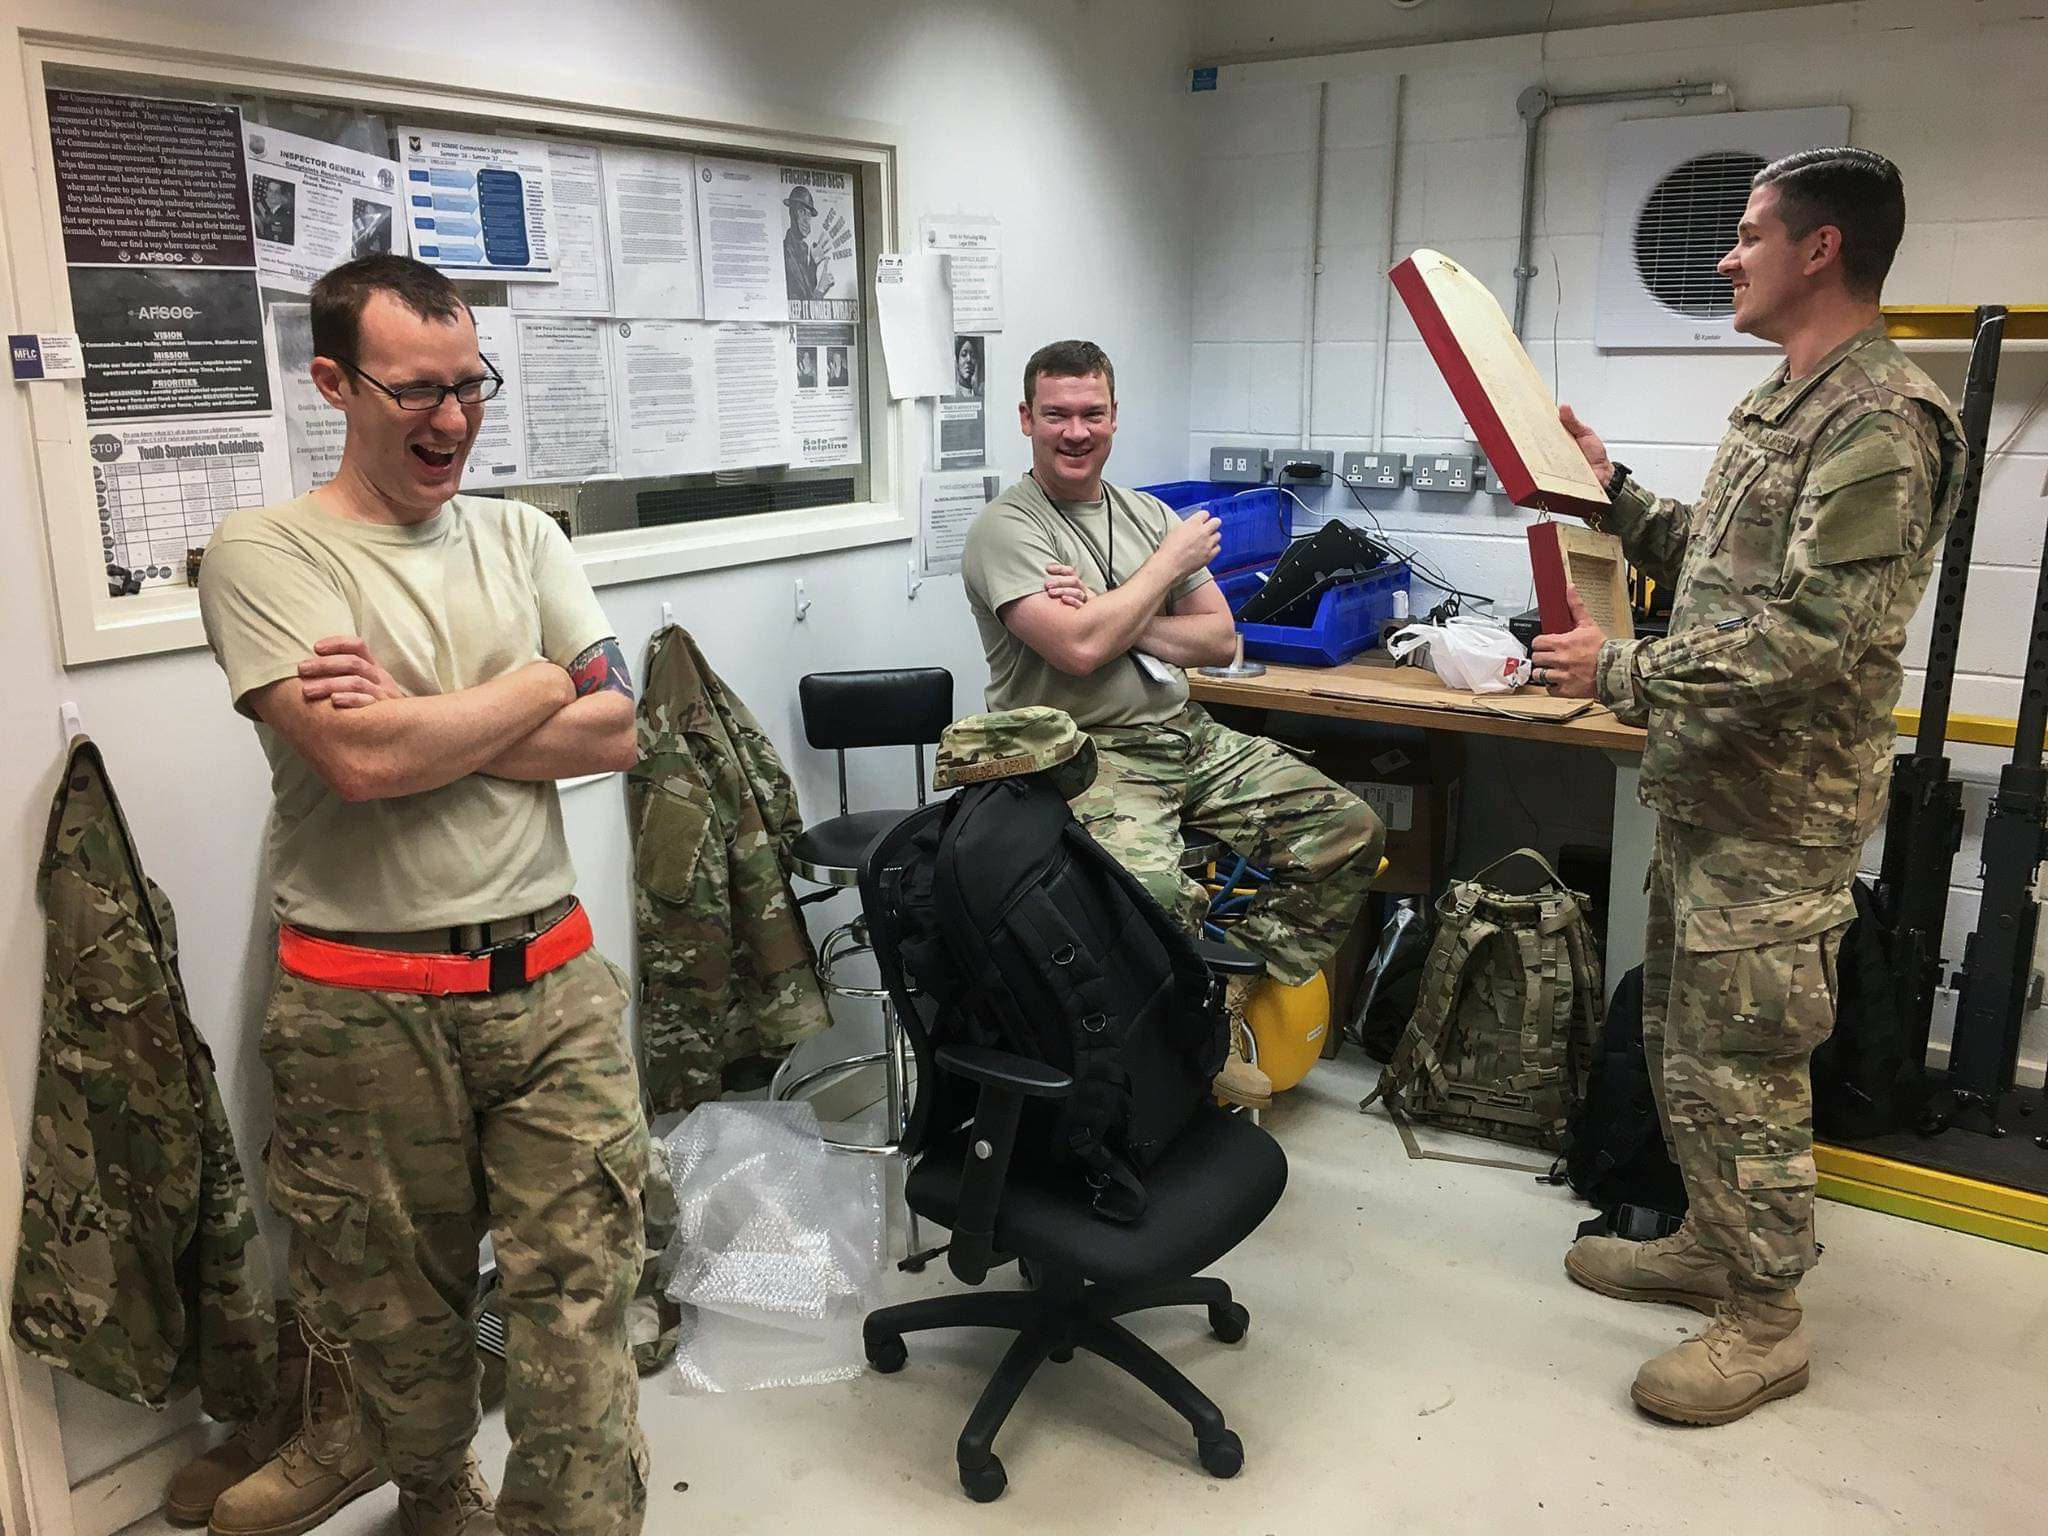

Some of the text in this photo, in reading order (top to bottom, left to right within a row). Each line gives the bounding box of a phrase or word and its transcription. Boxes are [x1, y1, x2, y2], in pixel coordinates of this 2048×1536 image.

[280, 150, 366, 178] INSPECTOR GENERAL
[138, 251, 184, 262] AFSOC
[138, 306, 194, 320] AFSOC
[153, 331, 184, 340] VISION
[14, 349, 38, 359] MFLC
[153, 351, 190, 360] MISSION
[152, 379, 198, 389] PRIORITIES
[803, 438, 828, 446] Safe
[90, 443, 121, 454] STOP
[137, 440, 265, 460] Youth Supervision Guidelines
[803, 443, 848, 452] Helpline
